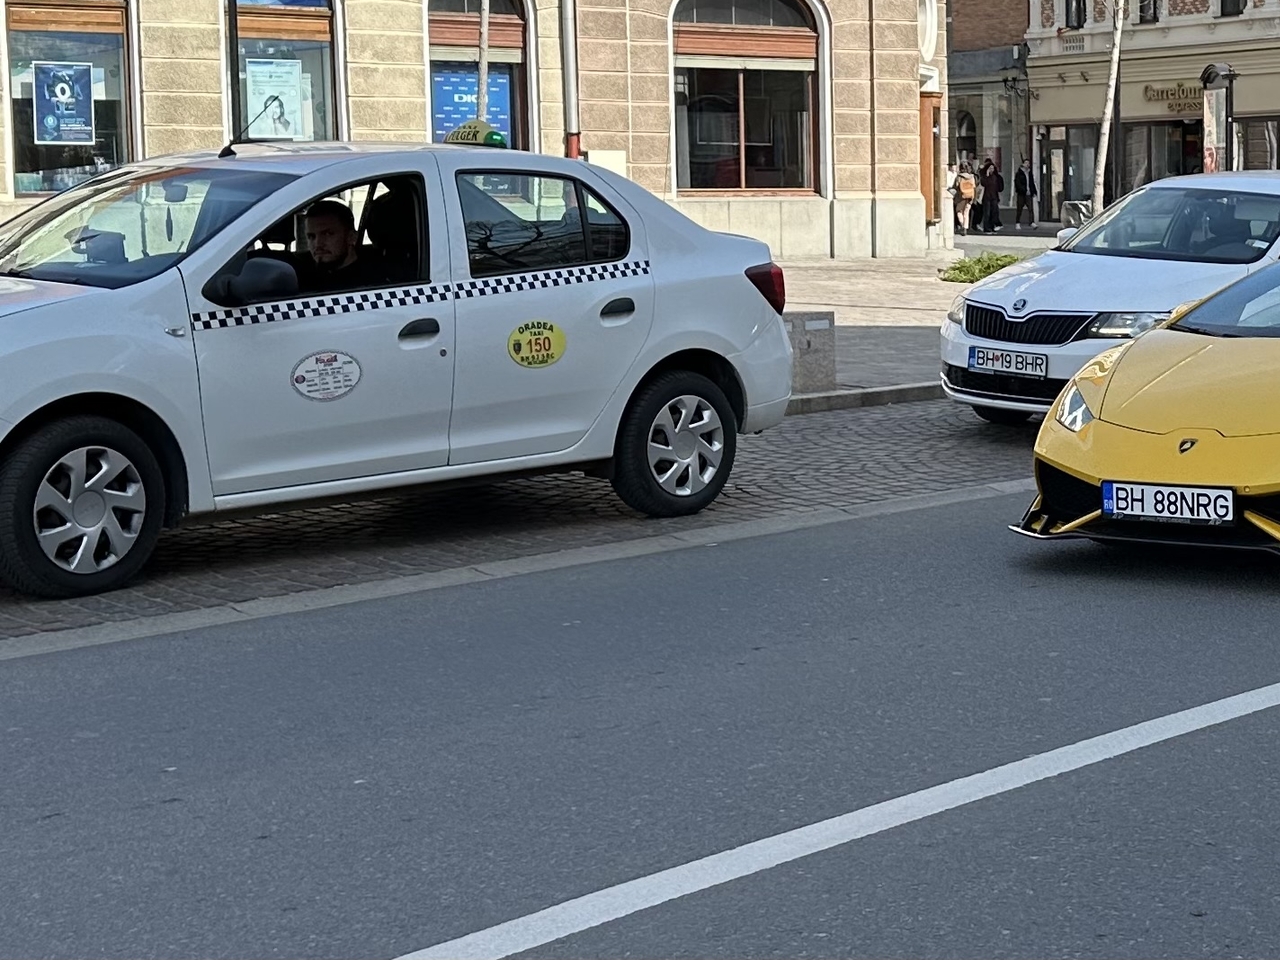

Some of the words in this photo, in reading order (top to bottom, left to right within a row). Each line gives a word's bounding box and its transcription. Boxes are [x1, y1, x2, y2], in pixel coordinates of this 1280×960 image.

[1143, 82, 1204, 102] Carrefour
[518, 322, 554, 334] ORADEA
[526, 336, 552, 354] 150
[976, 349, 995, 368] BH
[999, 352, 1013, 369] 19
[1014, 354, 1044, 373] BHR
[1115, 486, 1145, 513] BH
[1153, 489, 1230, 519] 88NRG
